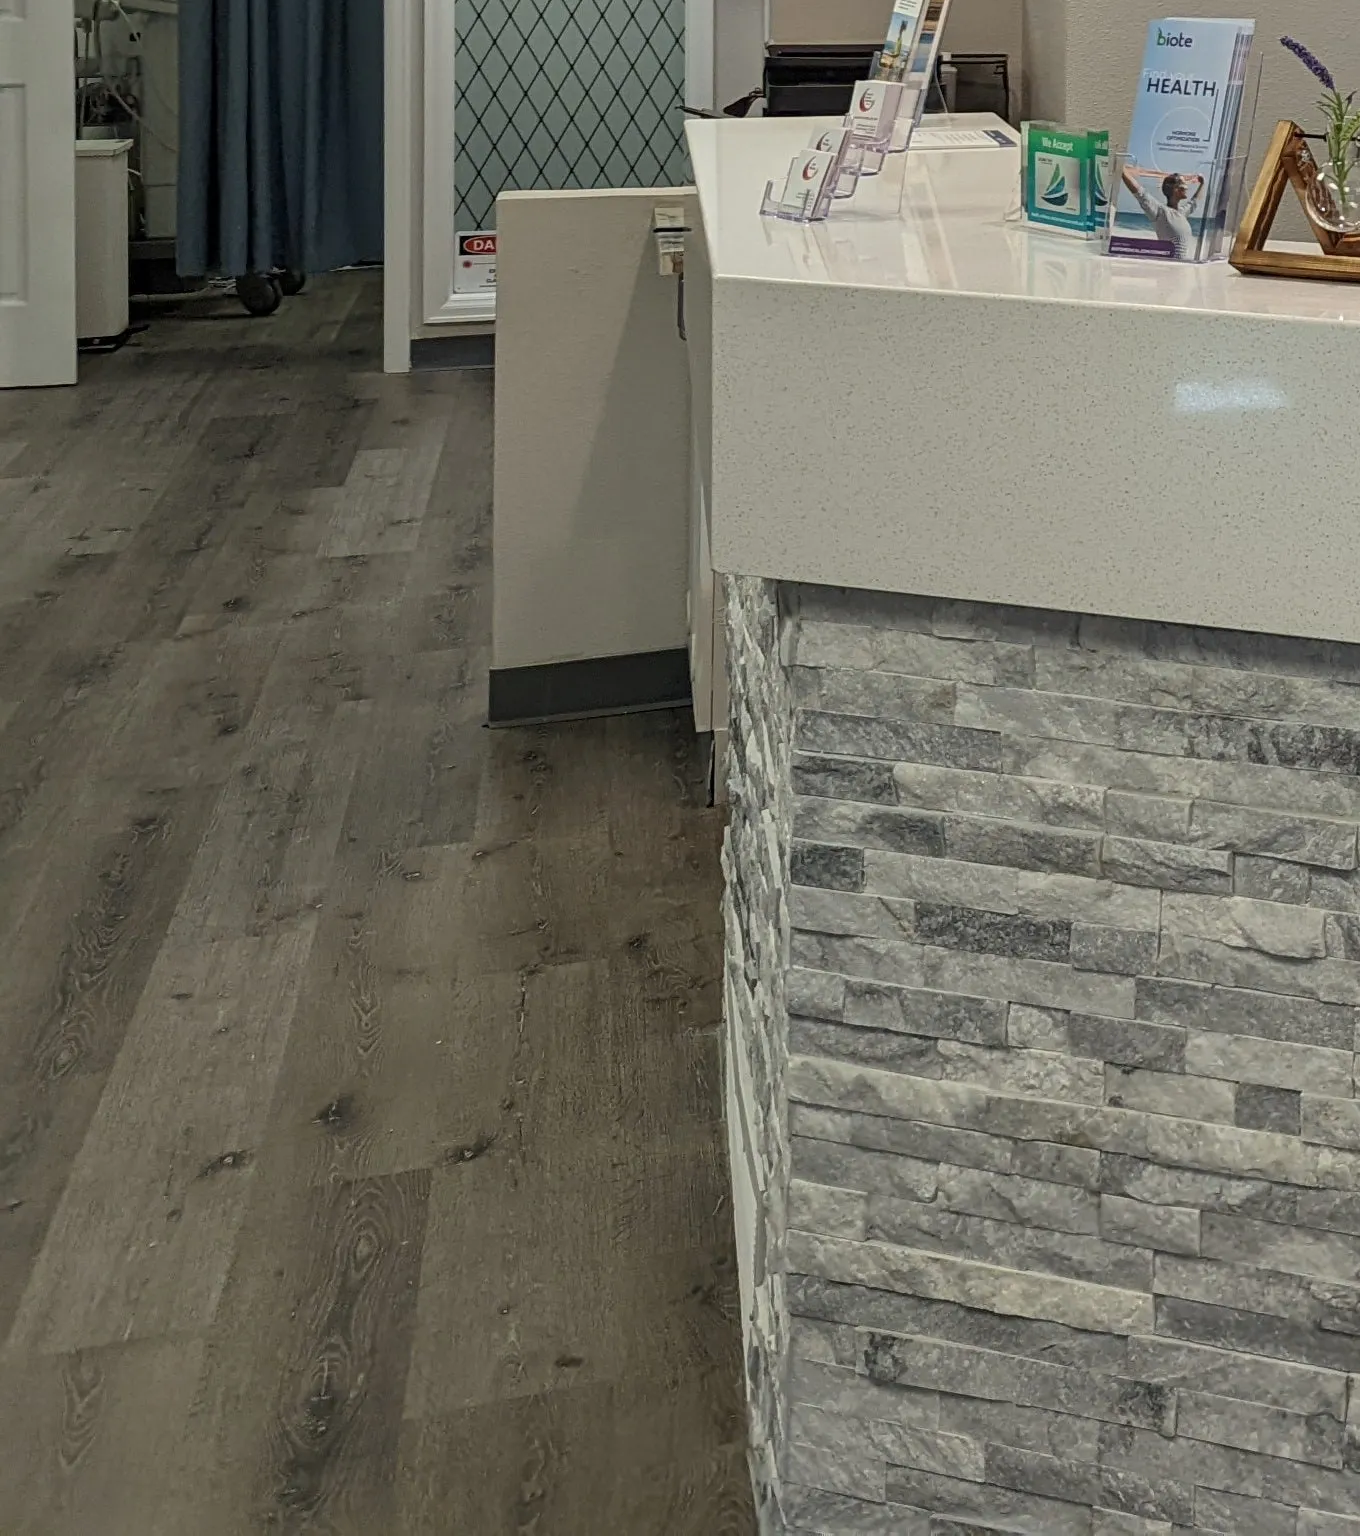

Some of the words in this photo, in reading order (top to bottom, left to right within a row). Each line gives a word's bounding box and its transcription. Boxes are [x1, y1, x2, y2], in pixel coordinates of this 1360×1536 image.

[1156, 27, 1193, 48] biote
[1147, 77, 1217, 97] HEALTH
[1042, 137, 1052, 148] We
[1052, 138, 1074, 153] Accept
